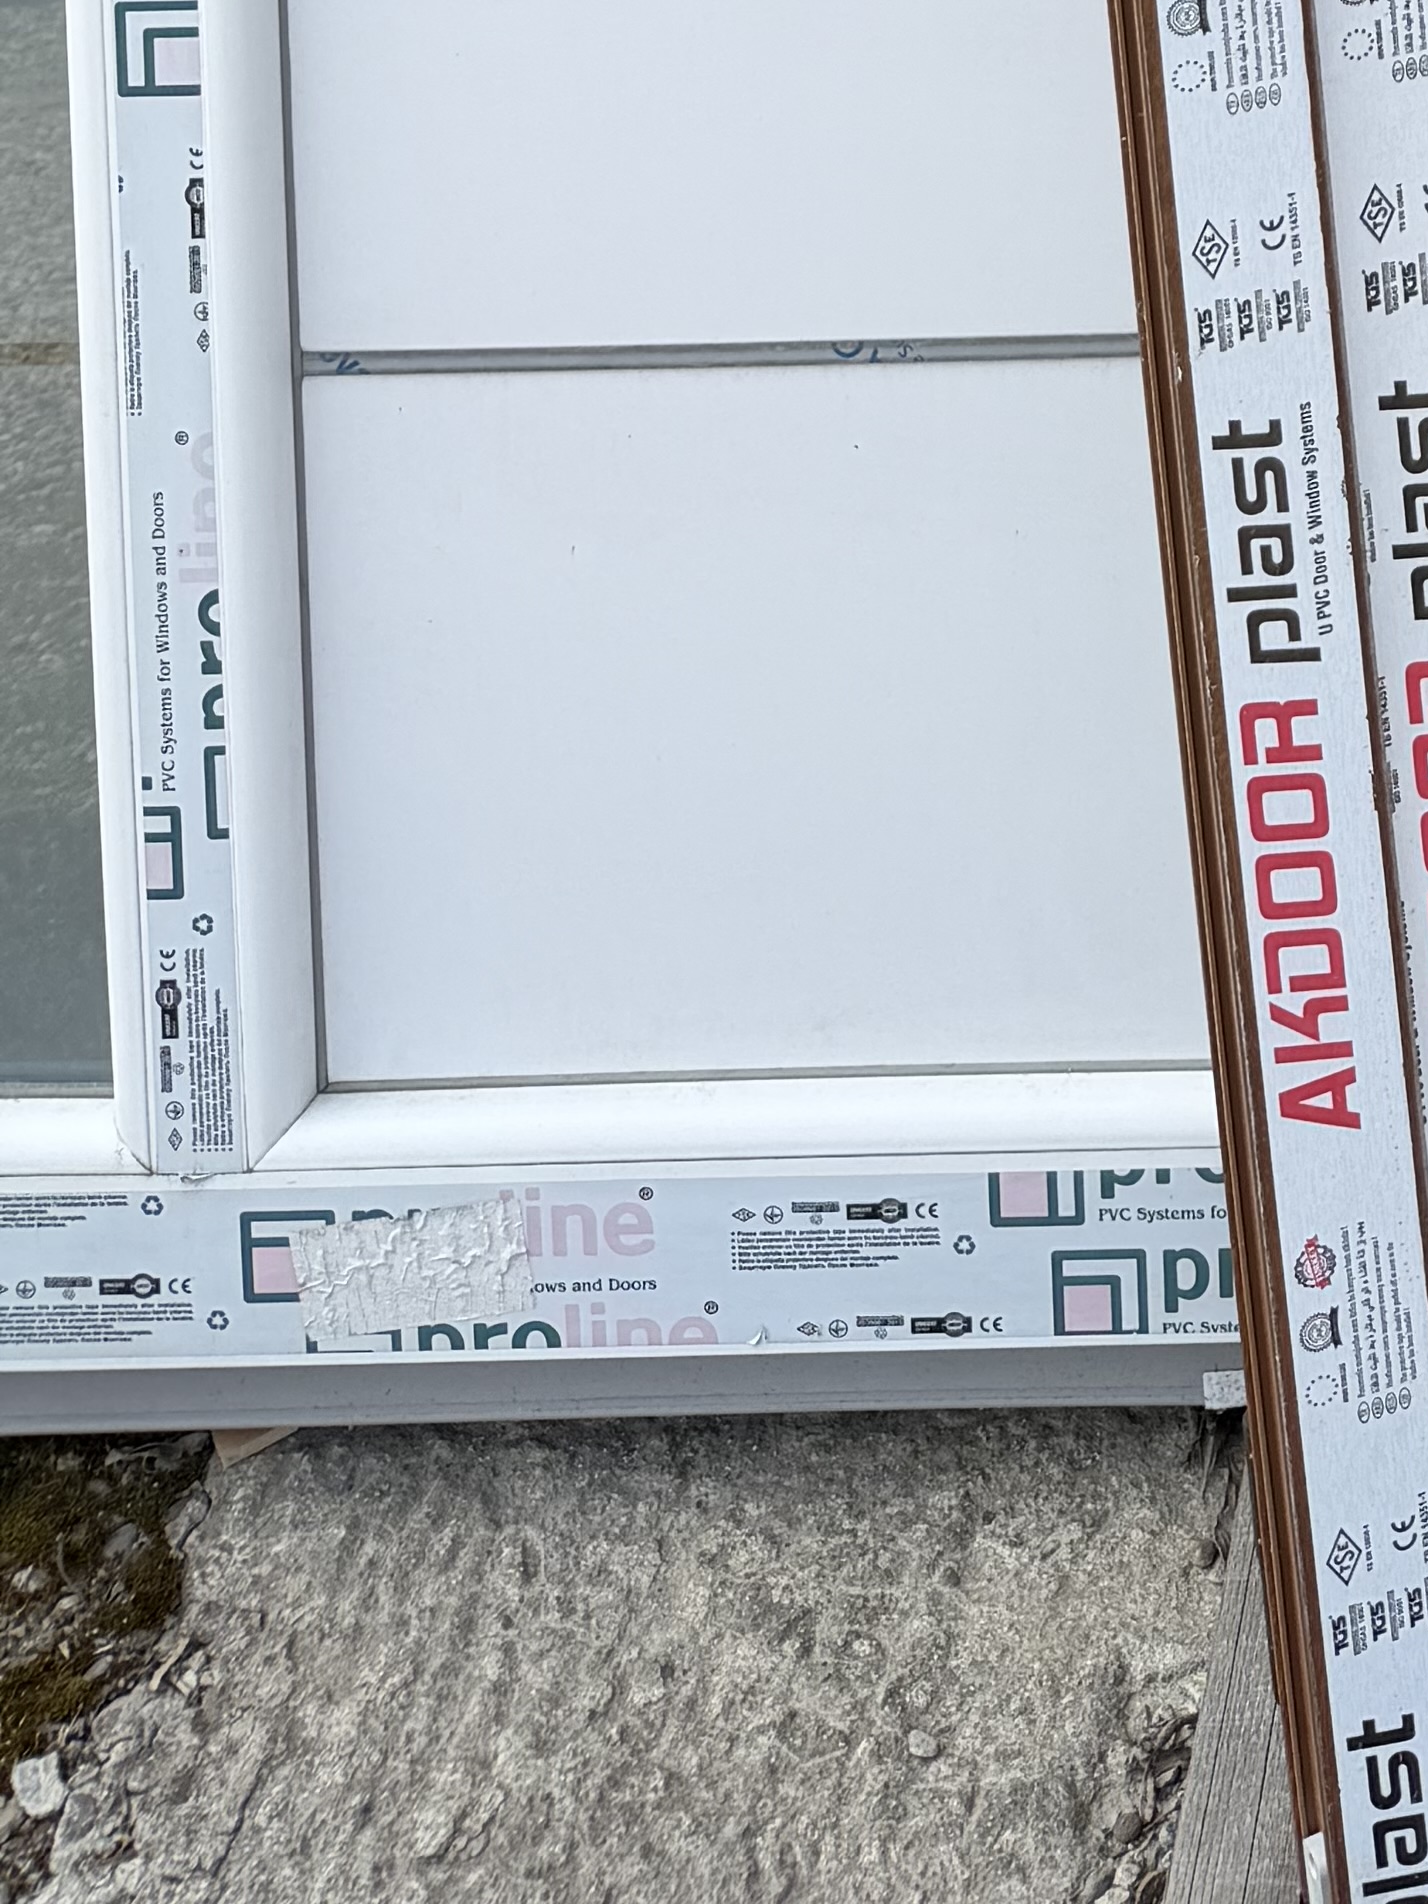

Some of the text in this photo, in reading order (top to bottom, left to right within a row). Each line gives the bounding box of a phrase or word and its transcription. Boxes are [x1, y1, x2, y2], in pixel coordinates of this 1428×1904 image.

[151, 491, 177, 791] PVC Systems for Windows and Doors
[1212, 419, 1361, 1130] AKDOOR plast
[572, 1278, 656, 1292] and Doors
[1099, 1205, 1227, 1223] PVC Systems fo
